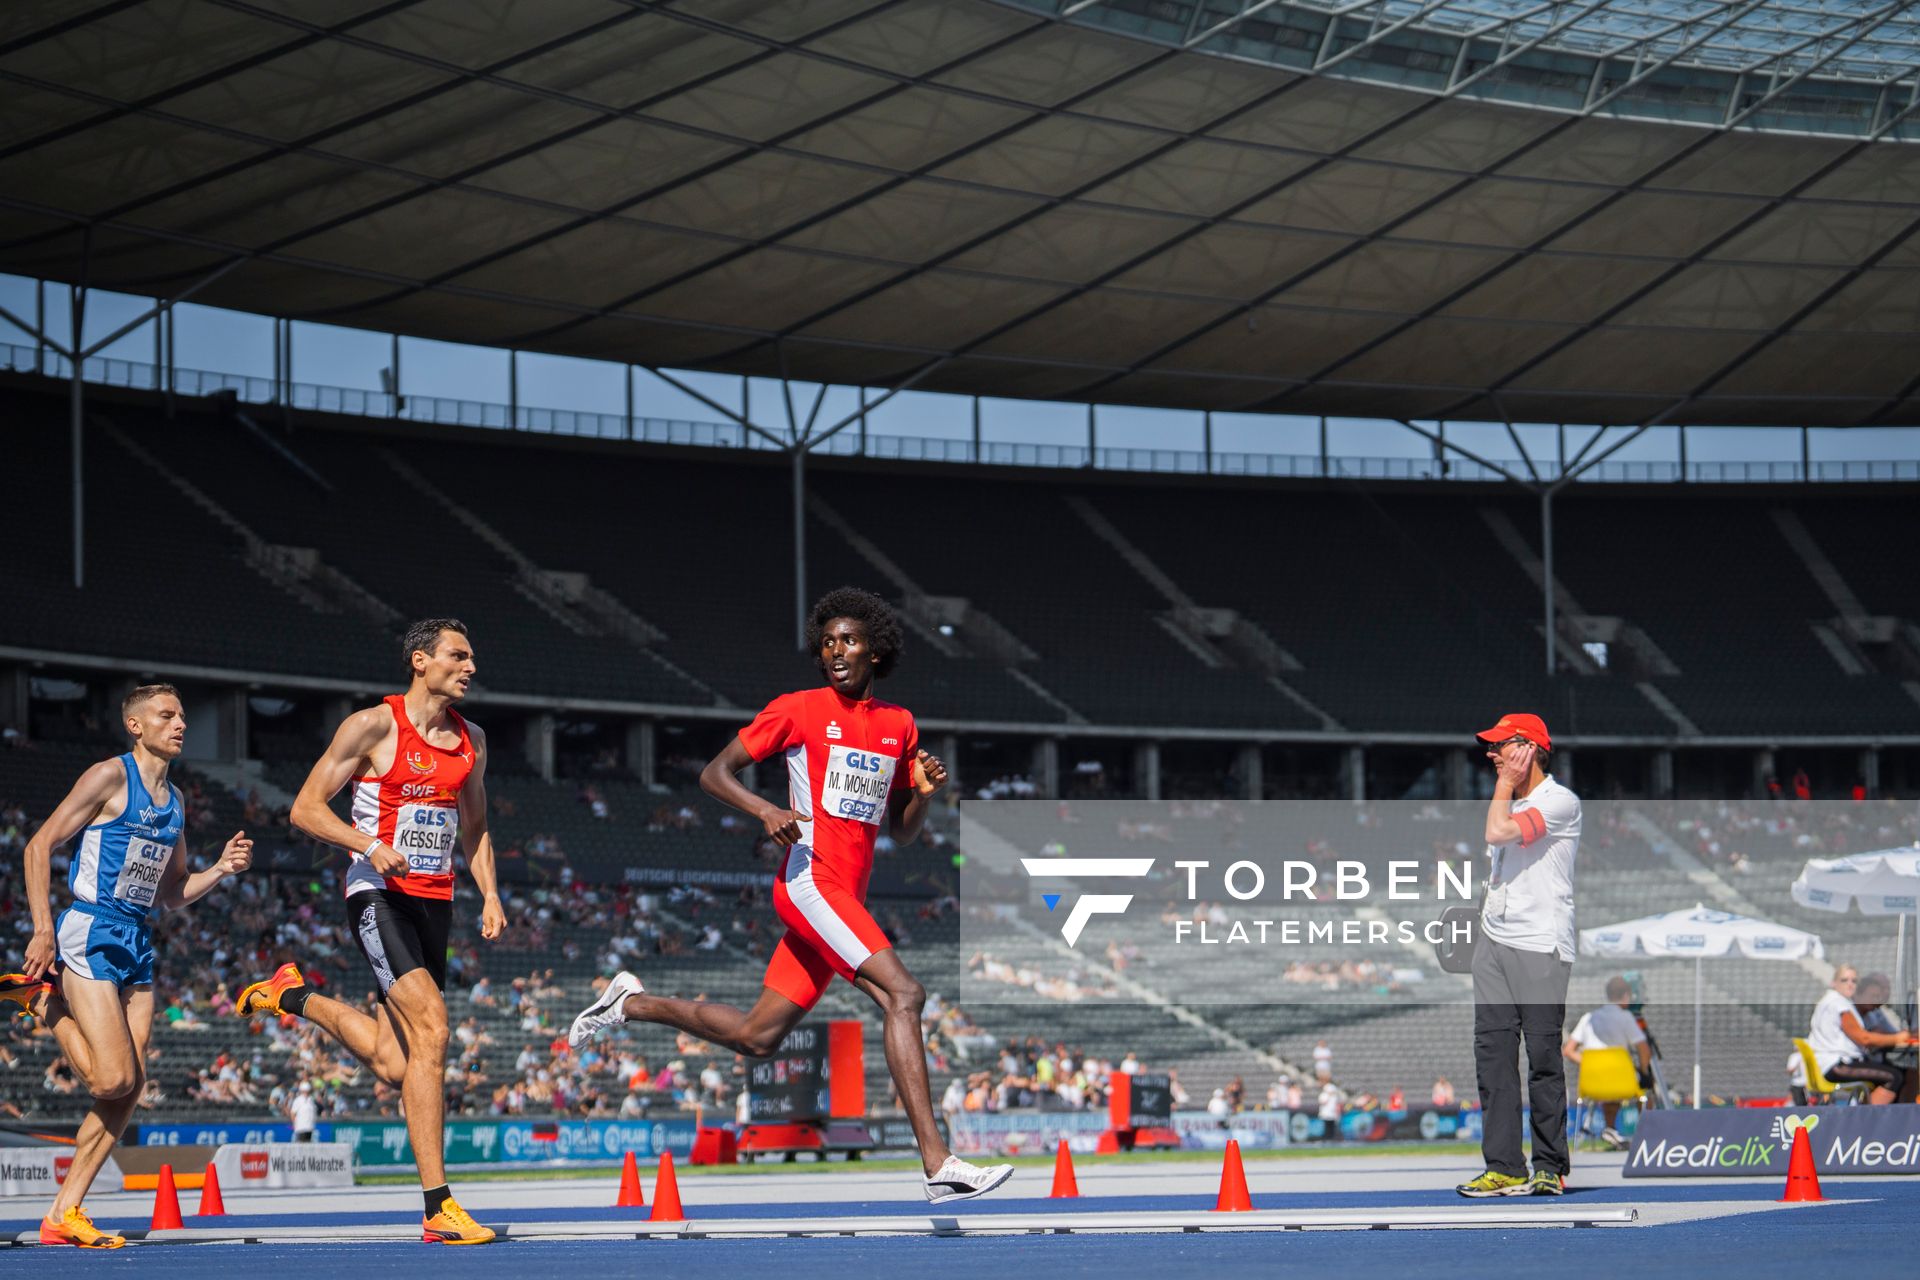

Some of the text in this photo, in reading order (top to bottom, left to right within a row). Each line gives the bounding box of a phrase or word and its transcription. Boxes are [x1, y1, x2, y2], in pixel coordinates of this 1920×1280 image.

[828, 771, 888, 799] M. MOHUMED
[400, 830, 452, 850] KESSLER
[1631, 1136, 1775, 1168] Mediclix
[1825, 1134, 1920, 1167] Medi
[1, 1163, 51, 1181] Matratze.
[287, 1156, 306, 1172] sind
[308, 1156, 346, 1171] Matratze.
